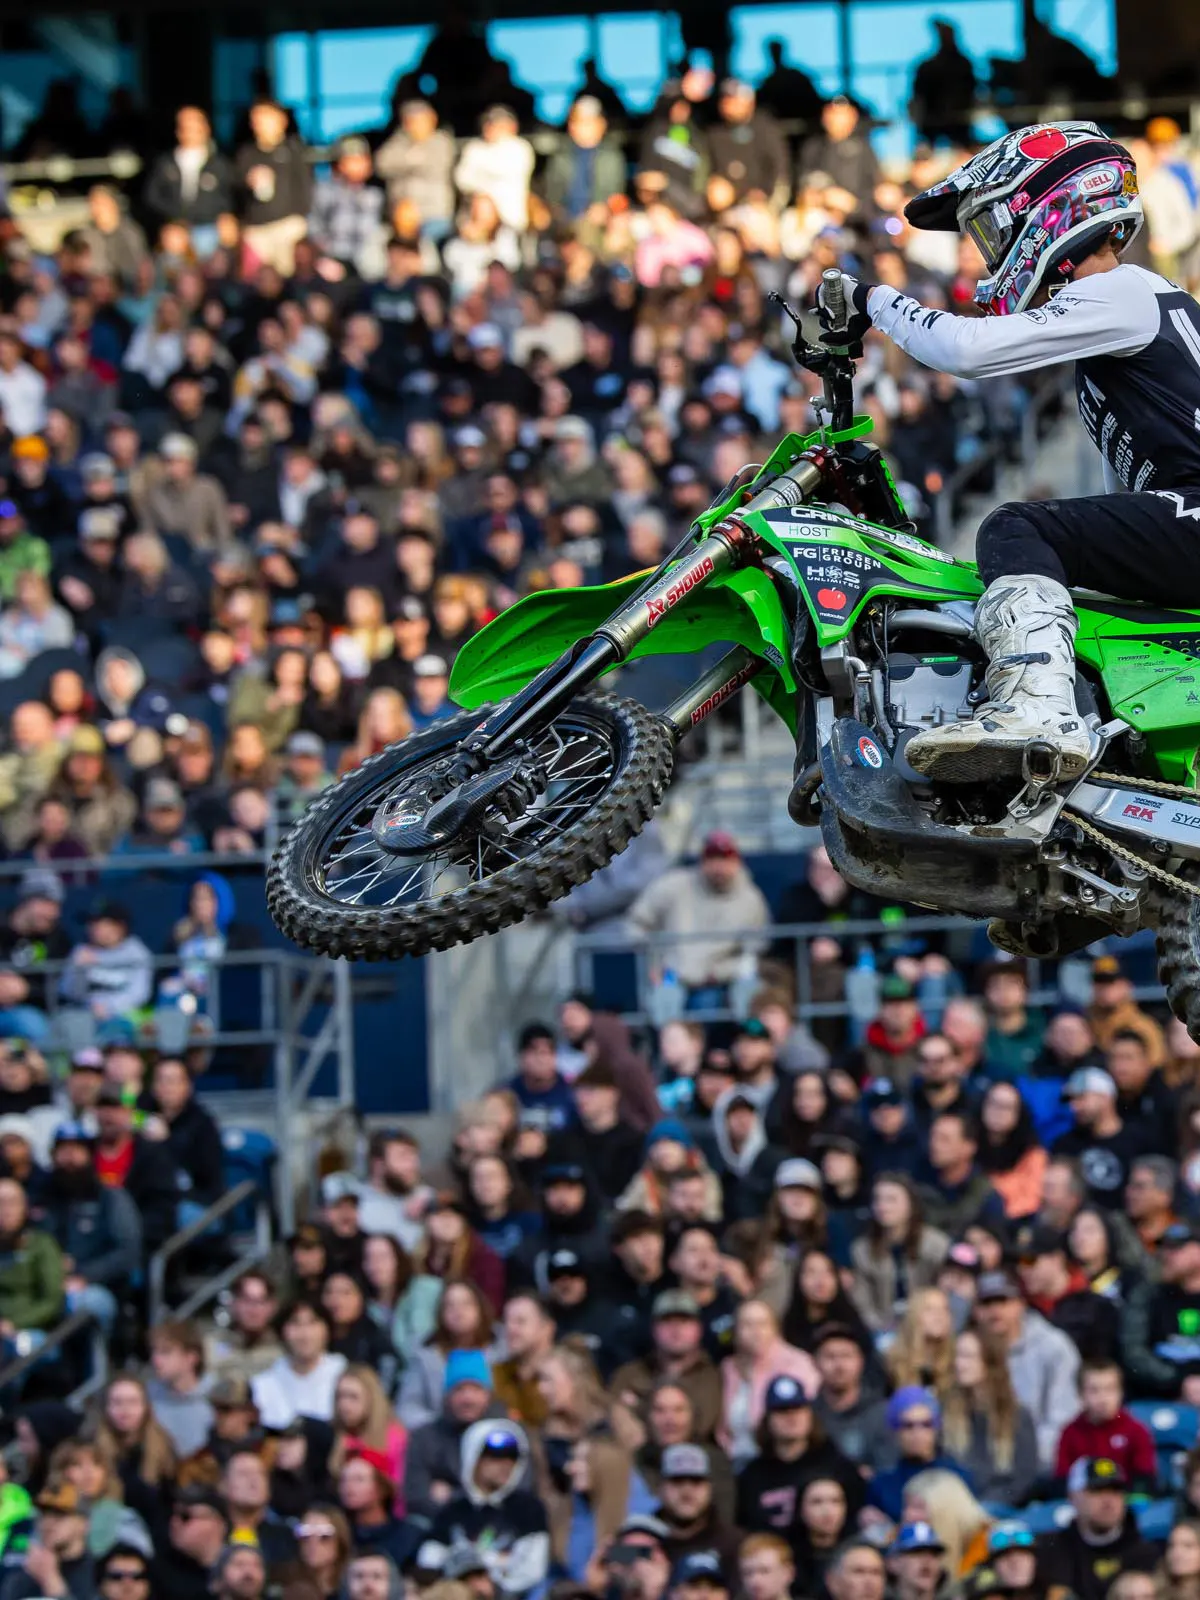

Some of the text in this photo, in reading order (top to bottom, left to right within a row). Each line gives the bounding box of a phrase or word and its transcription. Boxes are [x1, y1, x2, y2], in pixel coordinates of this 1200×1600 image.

[1083, 173, 1112, 190] BELL
[789, 526, 831, 538] HOST
[793, 548, 817, 559] FG
[822, 547, 882, 569] FRIESEN
[822, 554, 872, 571] GROUP
[666, 556, 715, 608] SHOWA
[807, 576, 860, 590] UNLIMITED
[1123, 804, 1158, 820] RK
